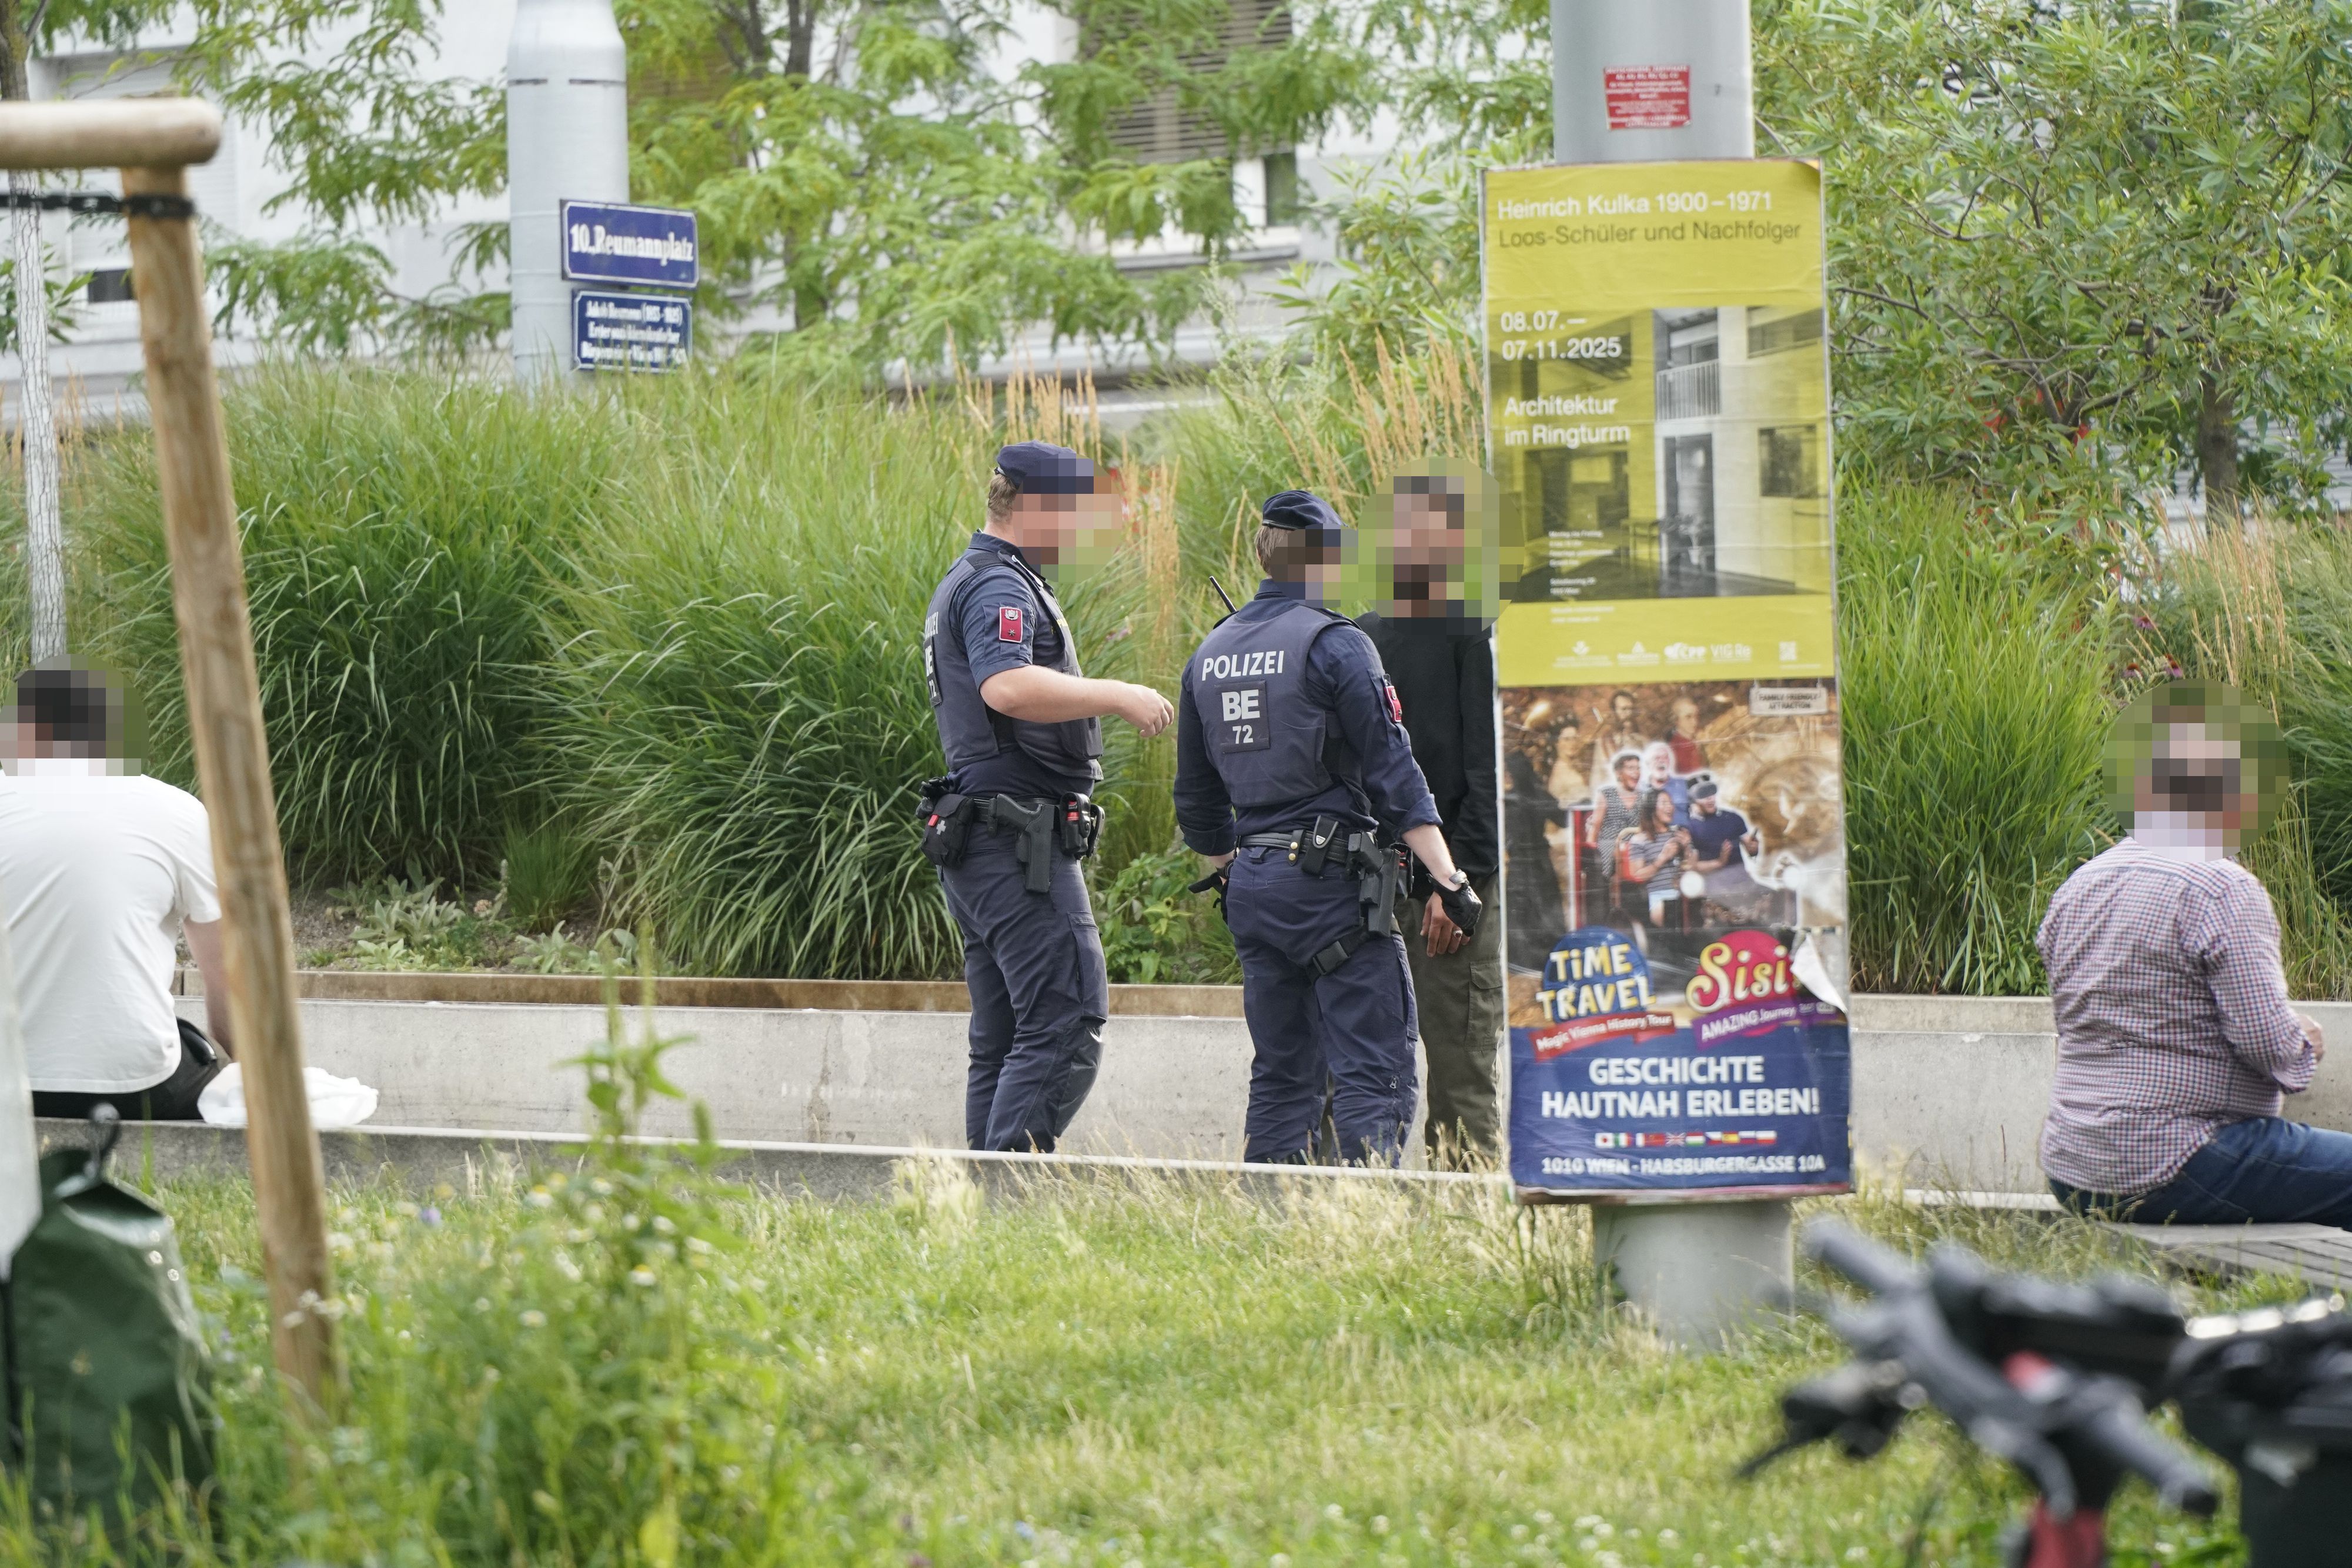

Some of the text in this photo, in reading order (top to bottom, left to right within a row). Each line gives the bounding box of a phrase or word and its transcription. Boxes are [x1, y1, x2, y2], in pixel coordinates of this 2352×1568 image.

[1497, 196, 1581, 220] Heinrich
[1588, 193, 1651, 215] Kulka
[1499, 220, 1802, 248] Loos-Schüler und Nachfolger
[1502, 336, 1623, 361] 07.11.2025
[1504, 394, 1619, 417] Architektur
[1504, 423, 1631, 450] im Ringturm
[1202, 650, 1284, 681] POLIZEI
[1221, 689, 1261, 721] BE
[1232, 724, 1254, 744] 72
[1535, 975, 1657, 1022] TRAVEL
[1568, 1023, 1608, 1040] Vienna
[1606, 1016, 1647, 1031] History
[1646, 1013, 1672, 1026] Tour
[1701, 1009, 1760, 1042] AMAZING
[1759, 1006, 1797, 1022] Journey
[1589, 1055, 1765, 1086] GESCHICHTE
[1541, 1087, 1820, 1118] HAUTNAH ERLEBEN!
[1541, 1157, 1585, 1174] 1010
[1586, 1158, 1631, 1175] WIEN
[1641, 1155, 1796, 1175] HABSBURGERGASSE
[1797, 1154, 1826, 1172] 10A
